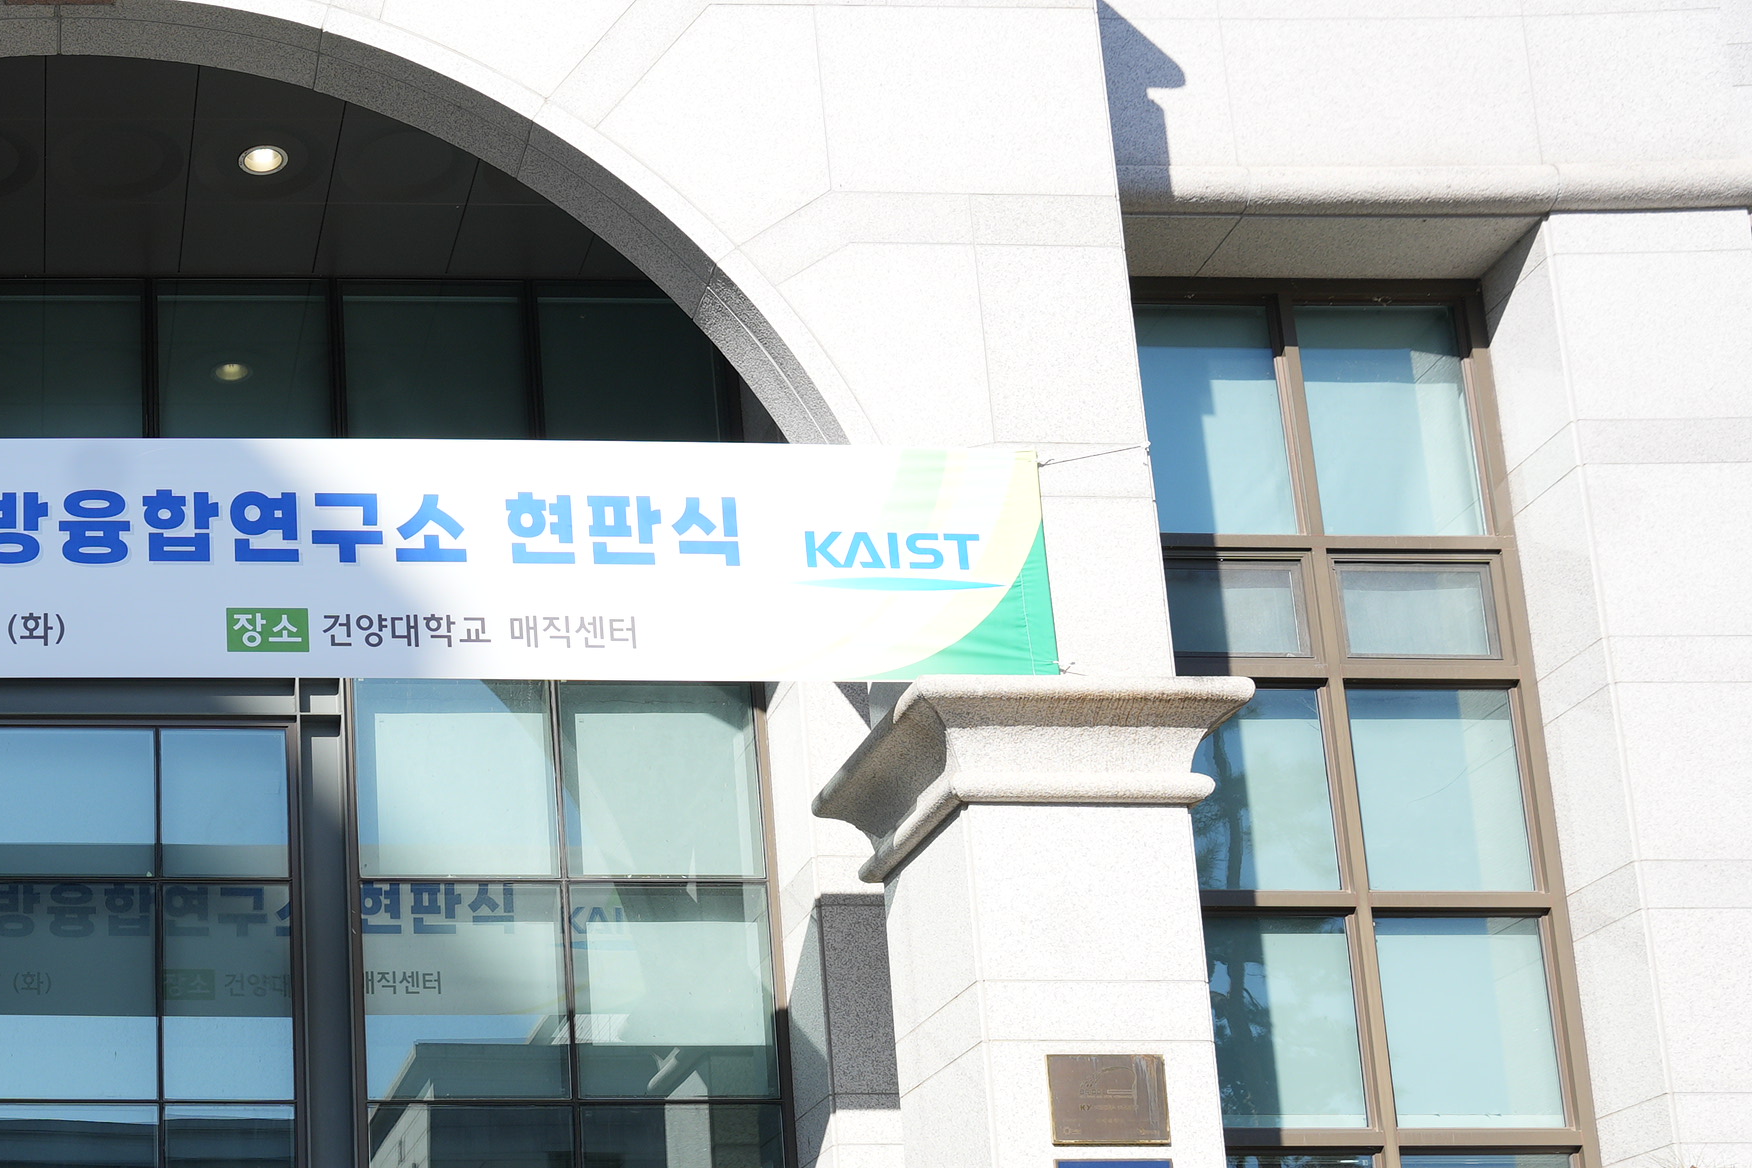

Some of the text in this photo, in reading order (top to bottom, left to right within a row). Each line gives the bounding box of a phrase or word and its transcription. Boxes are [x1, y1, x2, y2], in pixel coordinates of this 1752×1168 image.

[506, 490, 743, 569] 현판식
[804, 530, 980, 573] KAIST
[7, 613, 65, 647] (화)
[232, 612, 638, 649] 장소 건양대학교 매직센터
[12, 970, 54, 995] (화)
